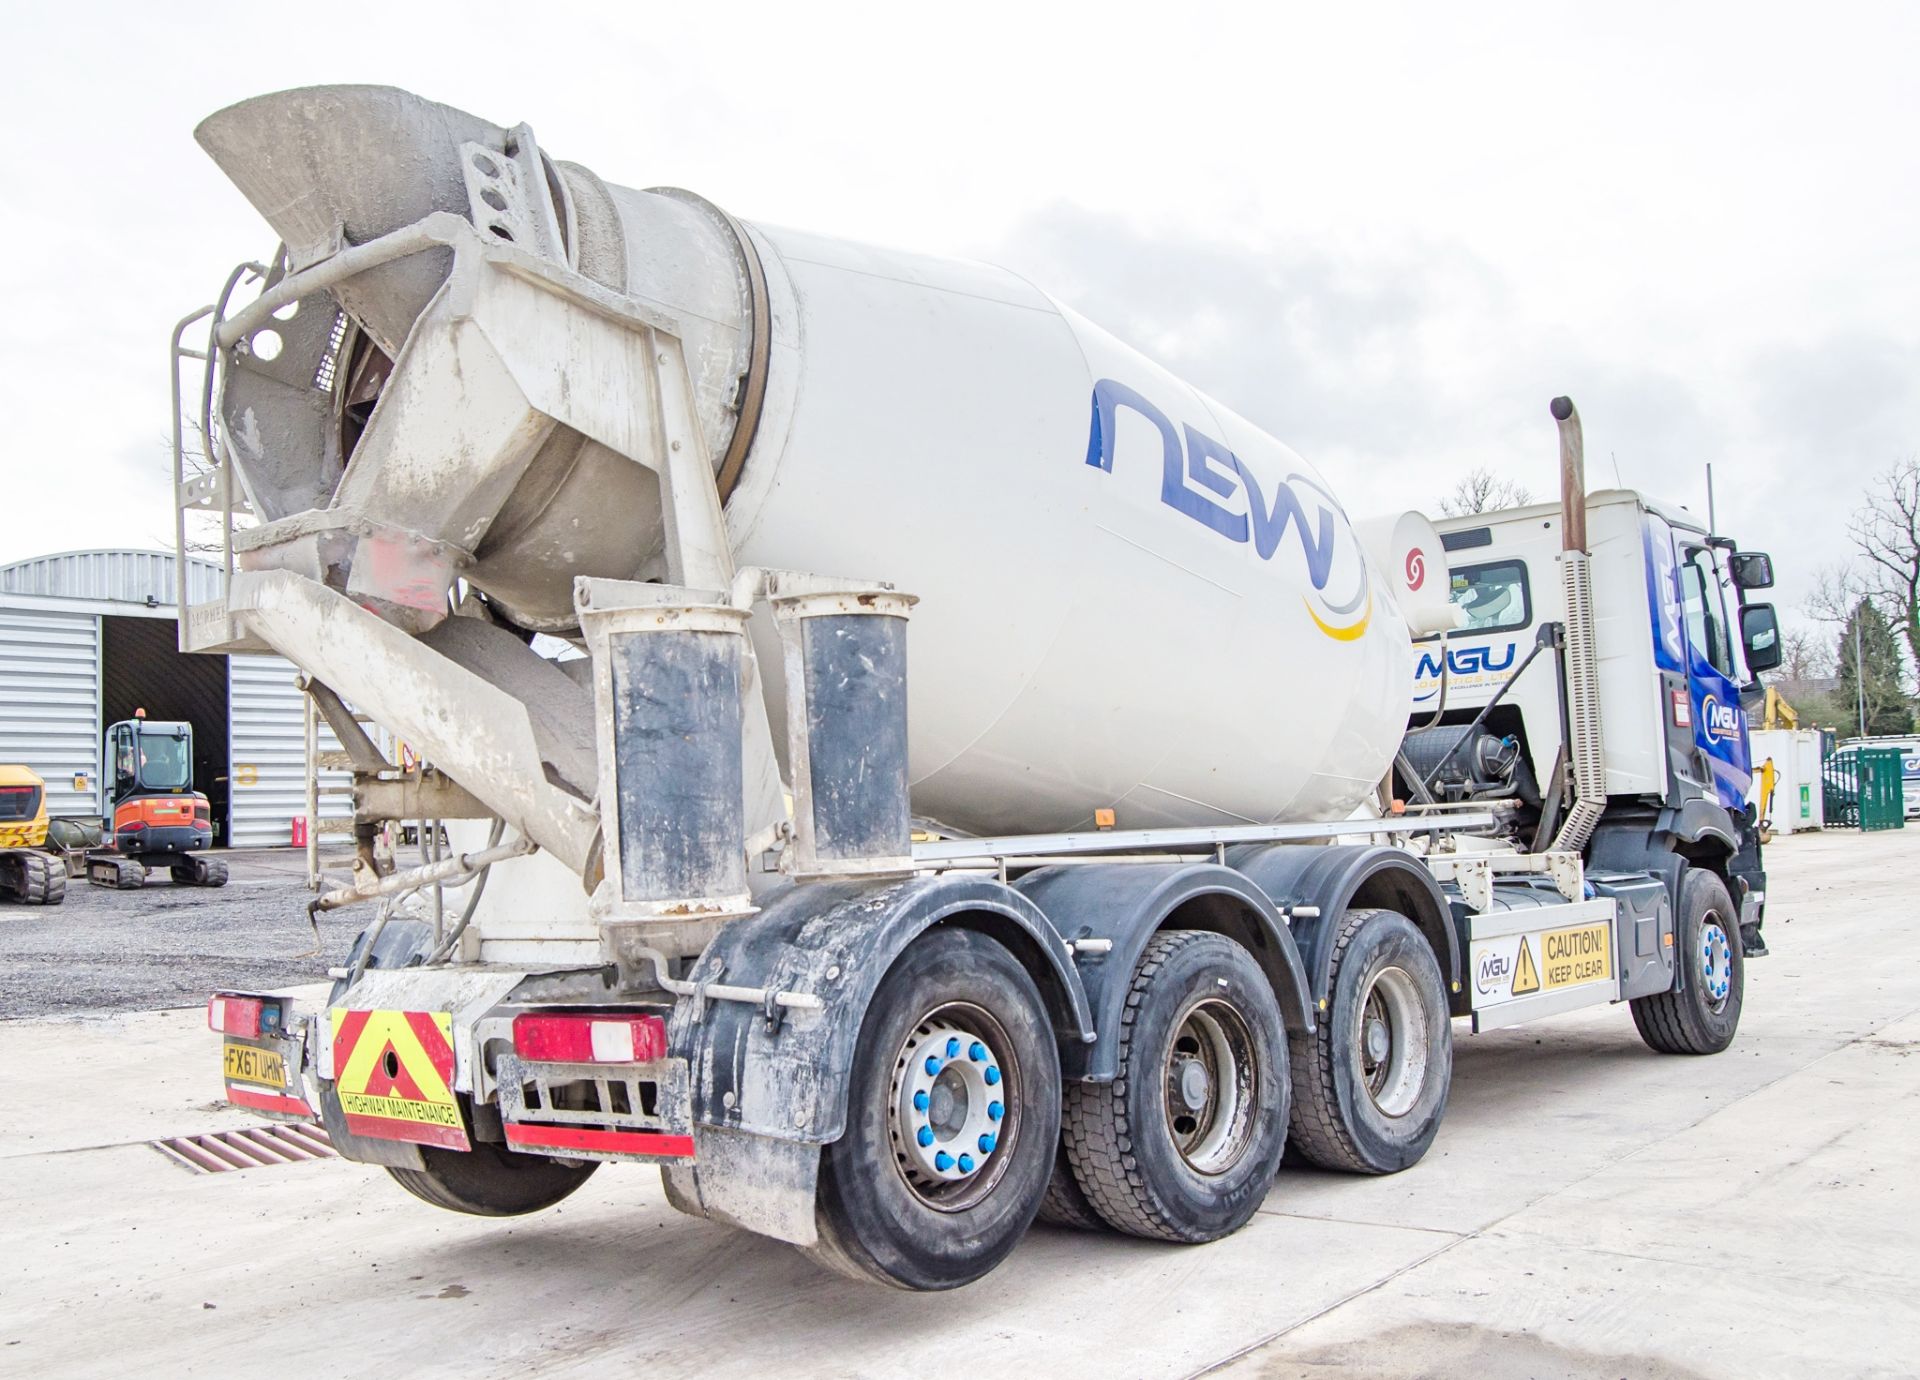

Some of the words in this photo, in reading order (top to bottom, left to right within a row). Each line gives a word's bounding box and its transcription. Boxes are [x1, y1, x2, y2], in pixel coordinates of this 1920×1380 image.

[1414, 643, 1516, 680] MGU
[1414, 675, 1484, 690] OGSTICS
[1711, 704, 1739, 731] MGU
[1547, 930, 1602, 961] CAUTION!
[1481, 956, 1510, 978] MGU
[1548, 965, 1572, 985] KEEP
[1575, 959, 1603, 980] CLEAR
[228, 1048, 258, 1077] FX67
[260, 1056, 281, 1082] UHN
[345, 1096, 386, 1115] HIGHWAY
[388, 1101, 456, 1125] MAINTENANCE
